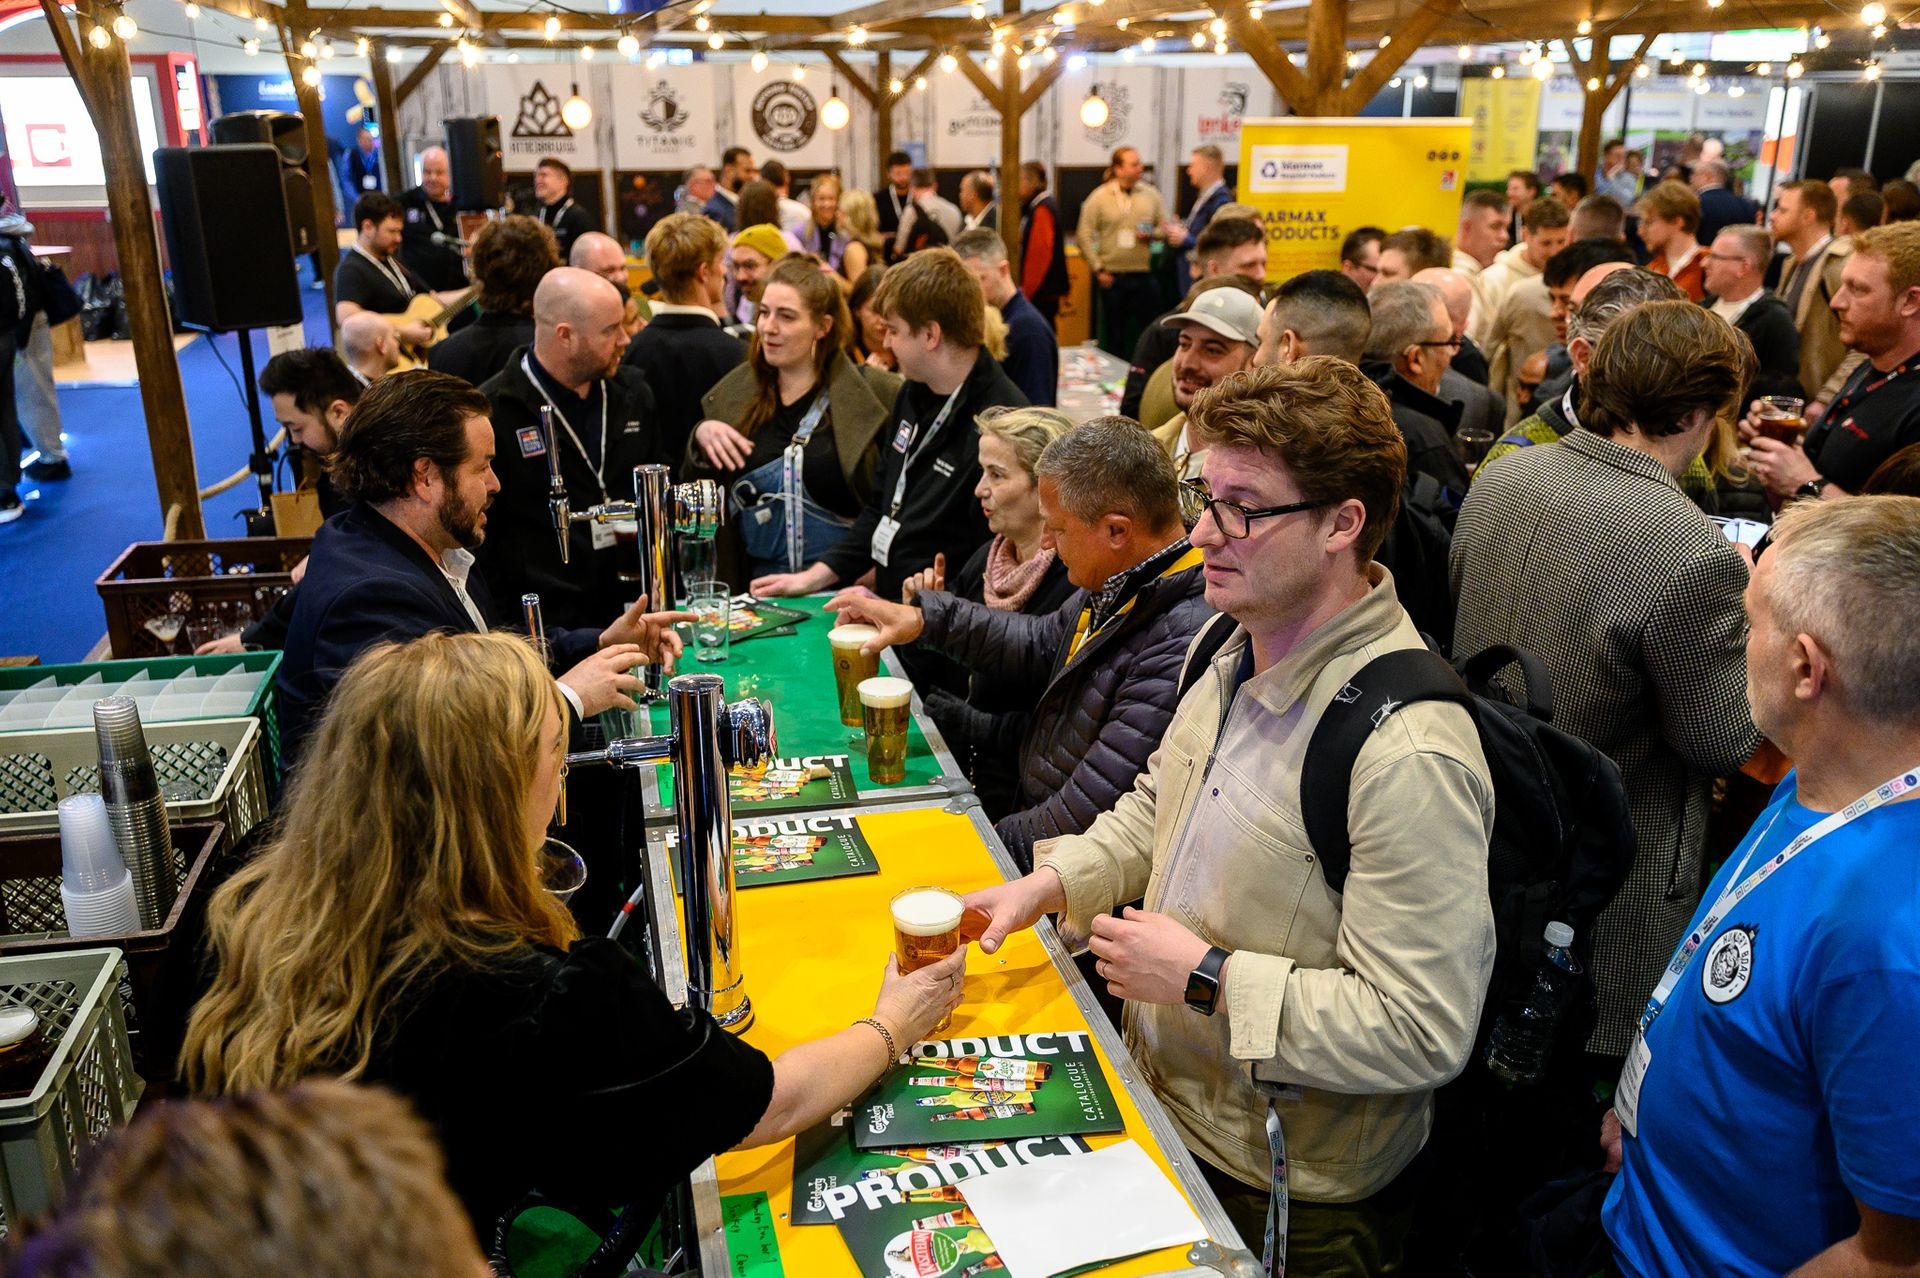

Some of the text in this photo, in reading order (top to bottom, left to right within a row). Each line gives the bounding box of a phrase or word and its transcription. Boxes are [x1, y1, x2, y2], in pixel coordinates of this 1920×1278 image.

[1264, 209, 1327, 223] ARMAX
[837, 834, 861, 868] CATALOGUE
[1722, 931, 1750, 982] HUNGRY BOAR
[1065, 1061, 1098, 1122] CATALOGUE
[868, 1103, 890, 1134] Carlsberg
